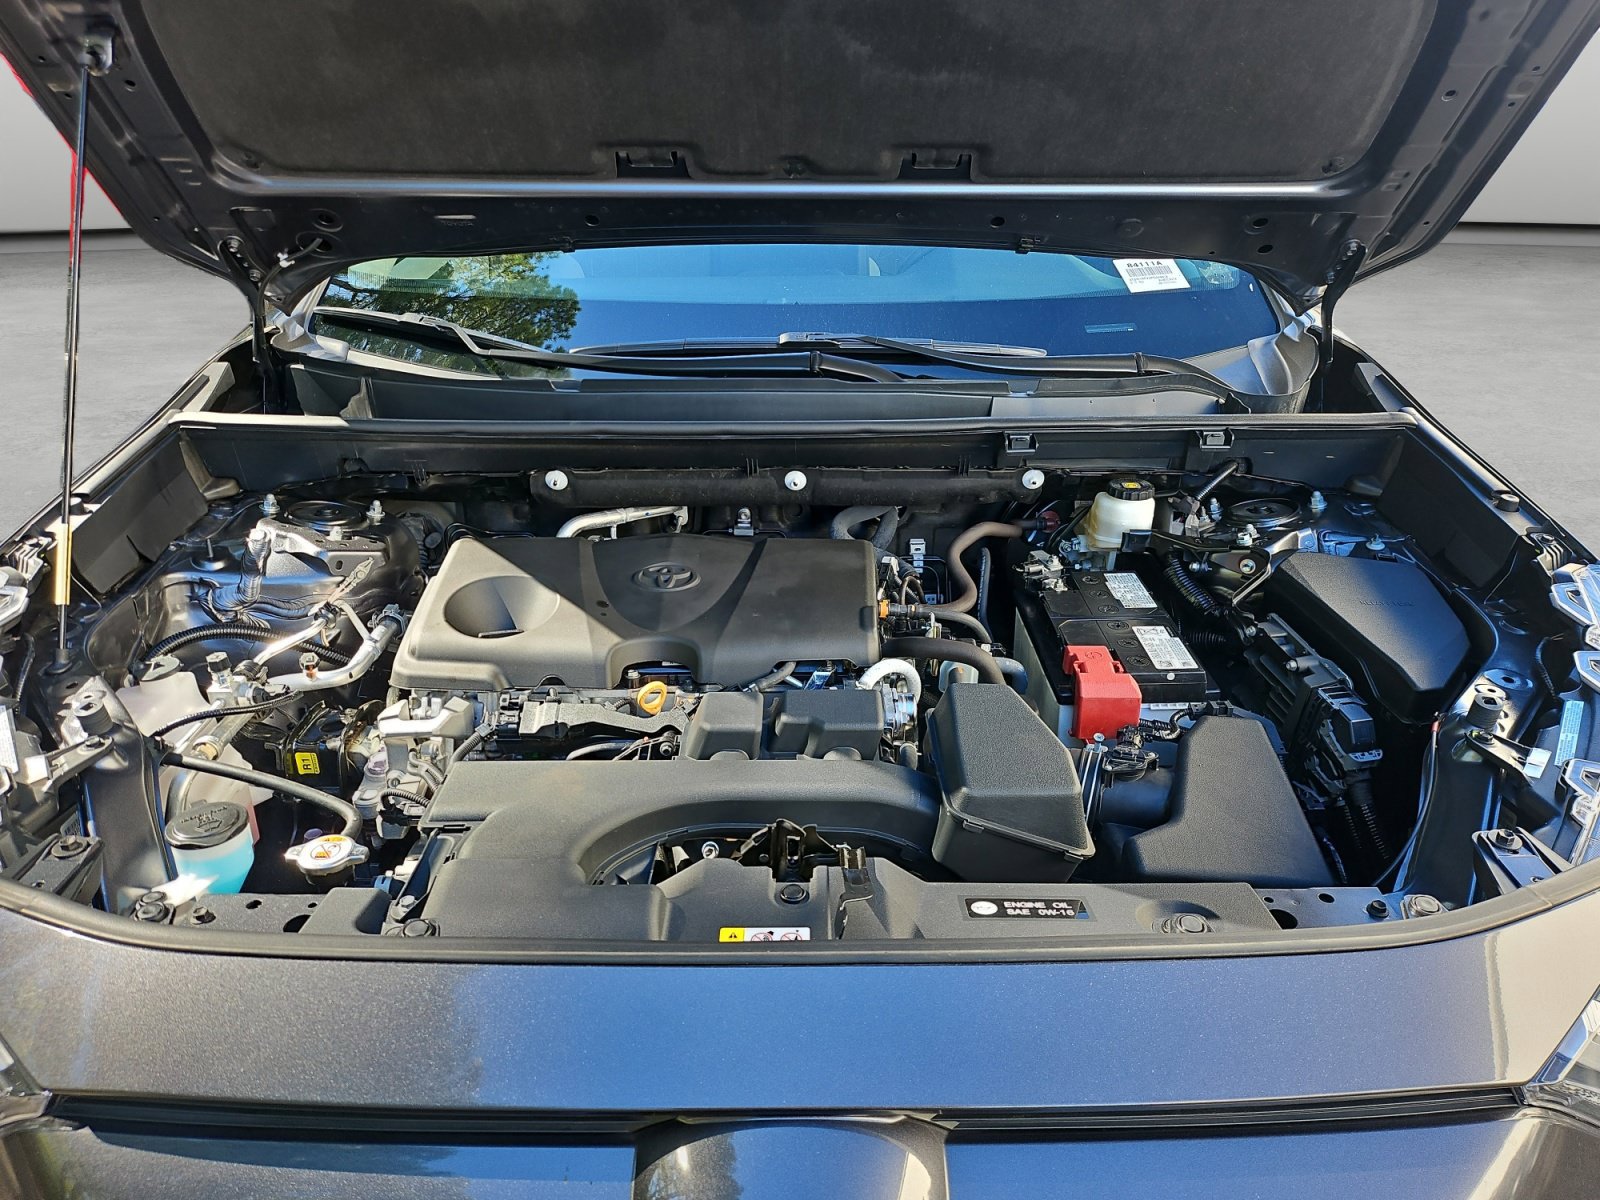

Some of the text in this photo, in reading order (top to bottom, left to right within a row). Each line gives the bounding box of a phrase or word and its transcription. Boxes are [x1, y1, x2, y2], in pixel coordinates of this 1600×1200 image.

[301, 758, 312, 770] R1
[1003, 901, 1073, 909] ENGINE OIL
[1006, 908, 1075, 916] SAE 0W-16
